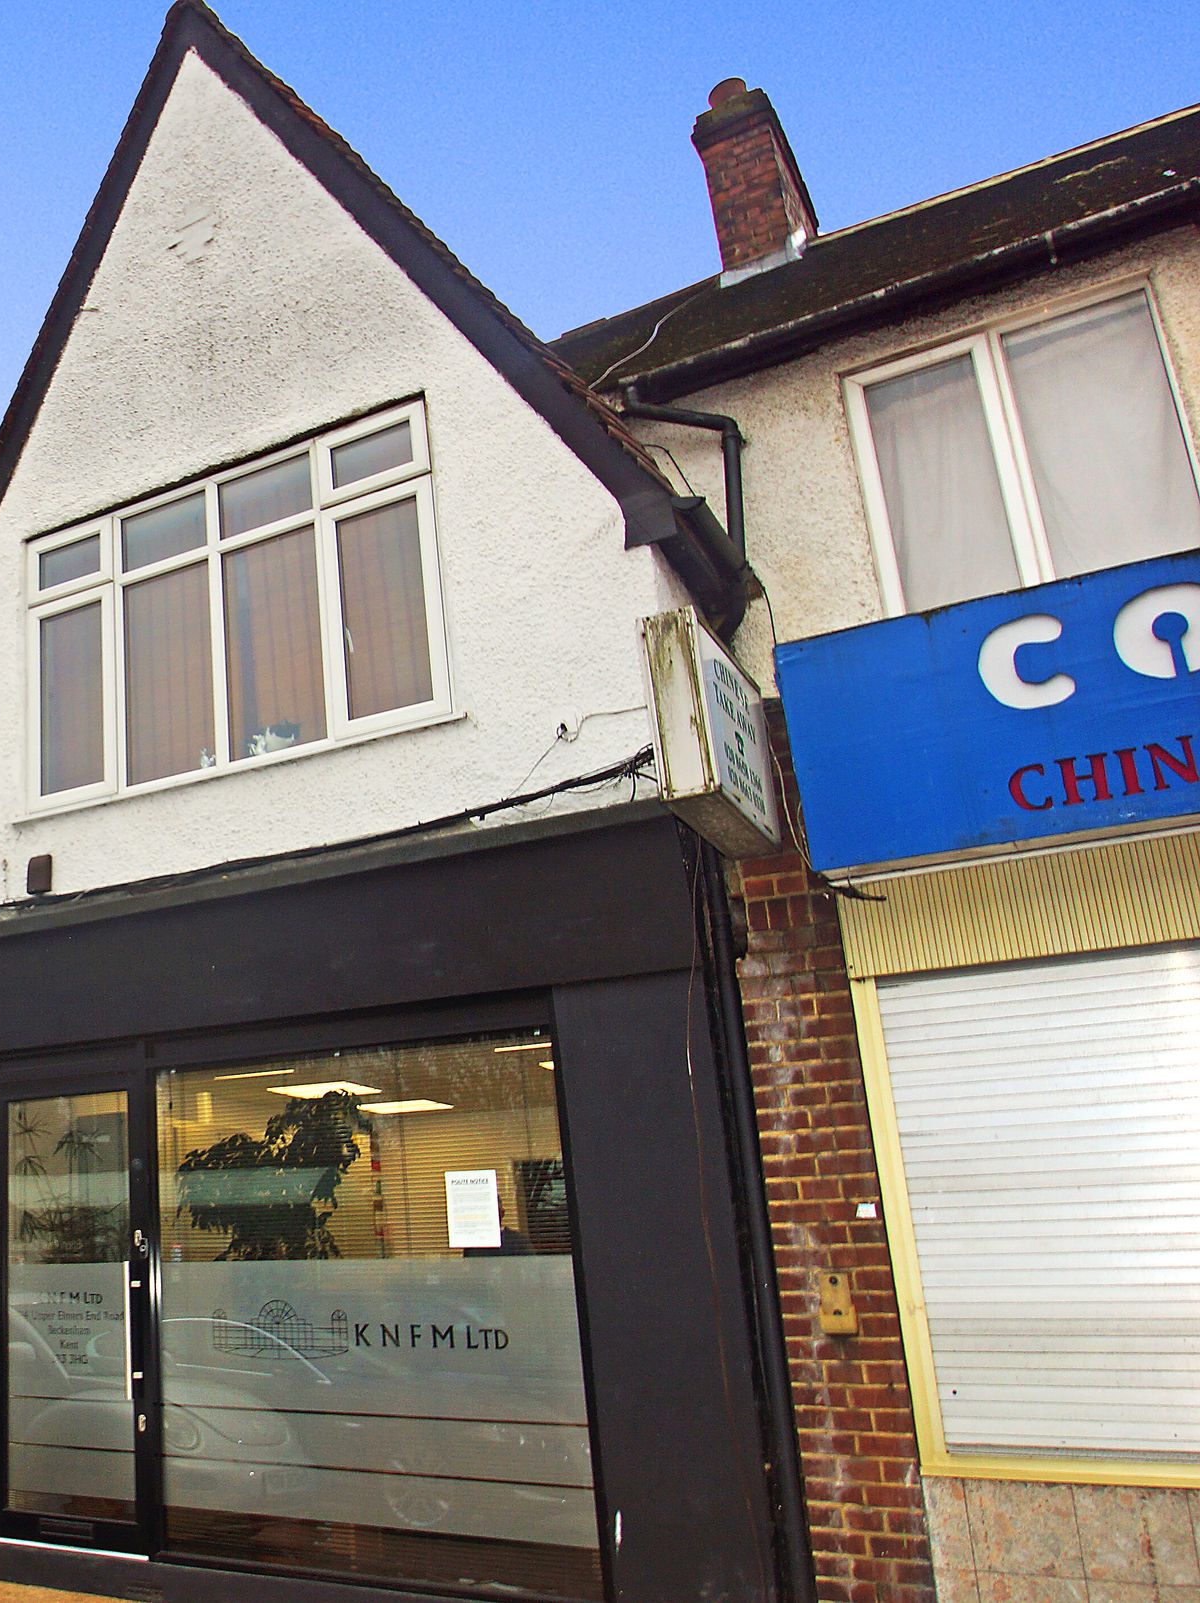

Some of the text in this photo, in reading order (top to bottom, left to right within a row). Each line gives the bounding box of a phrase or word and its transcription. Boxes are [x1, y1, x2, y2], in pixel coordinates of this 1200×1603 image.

[712, 681, 757, 745] TAKE AWAY
[713, 658, 750, 716] CHINESE
[1008, 735, 1200, 811] CHIN
[83, 1292, 104, 1304] LTD
[466, 1325, 509, 1349] LTD
